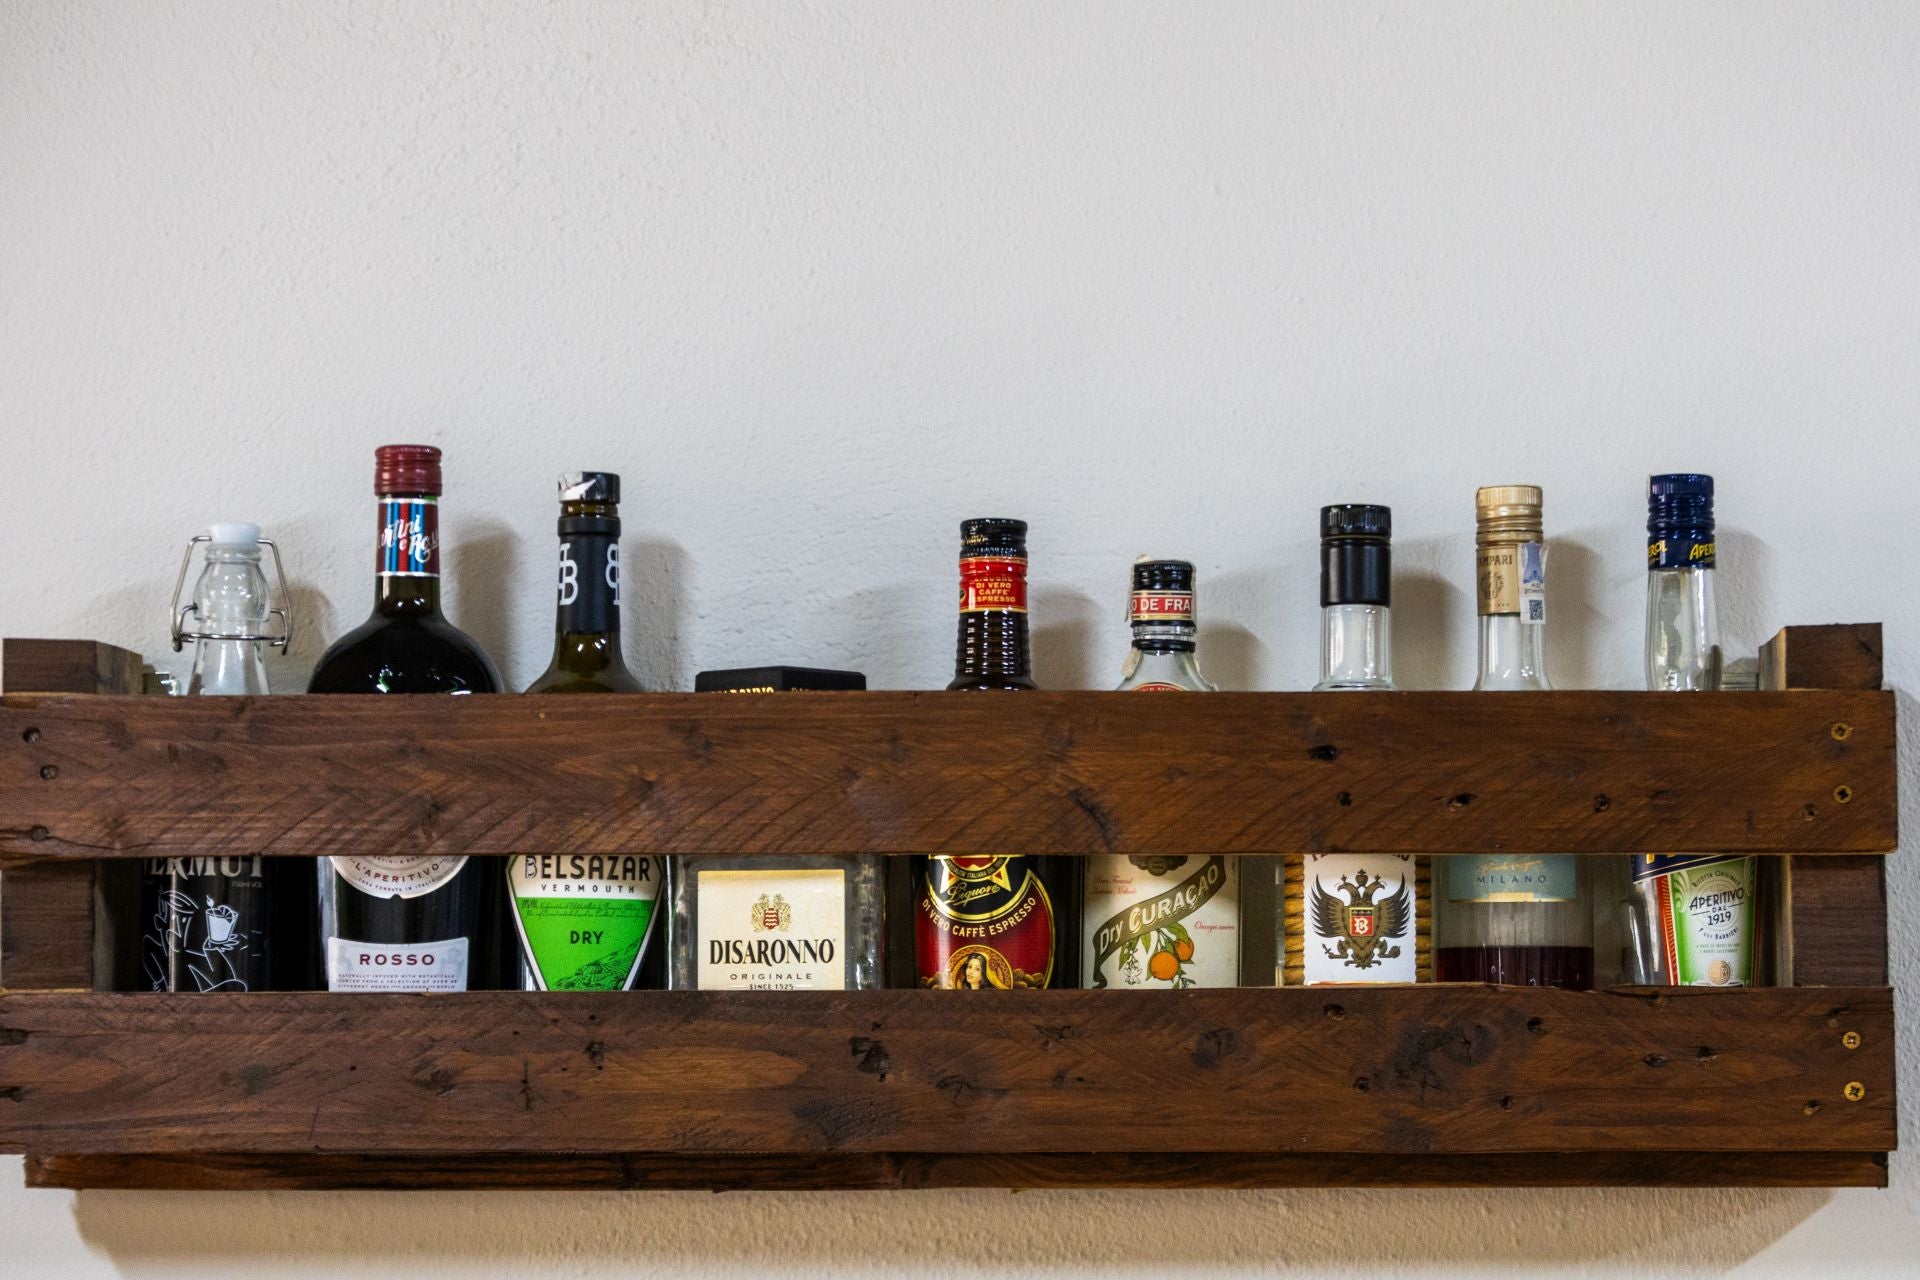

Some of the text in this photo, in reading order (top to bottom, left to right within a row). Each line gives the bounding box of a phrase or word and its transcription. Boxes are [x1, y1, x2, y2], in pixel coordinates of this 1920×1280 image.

[1140, 599, 1159, 610] DE
[525, 855, 651, 881] BELSAZAR
[541, 884, 635, 893] VERMOUTH
[1690, 888, 1744, 911] APERITIVO
[929, 911, 950, 931] VERO
[952, 925, 986, 937] CAFFÈ
[989, 897, 1036, 935] ESPRESSO
[1100, 865, 1219, 955] Dry CURAÇAO
[1707, 911, 1732, 926] 1919
[570, 931, 604, 944] DRY
[359, 954, 435, 965] ROSSO
[709, 939, 836, 967] DISARONNO
